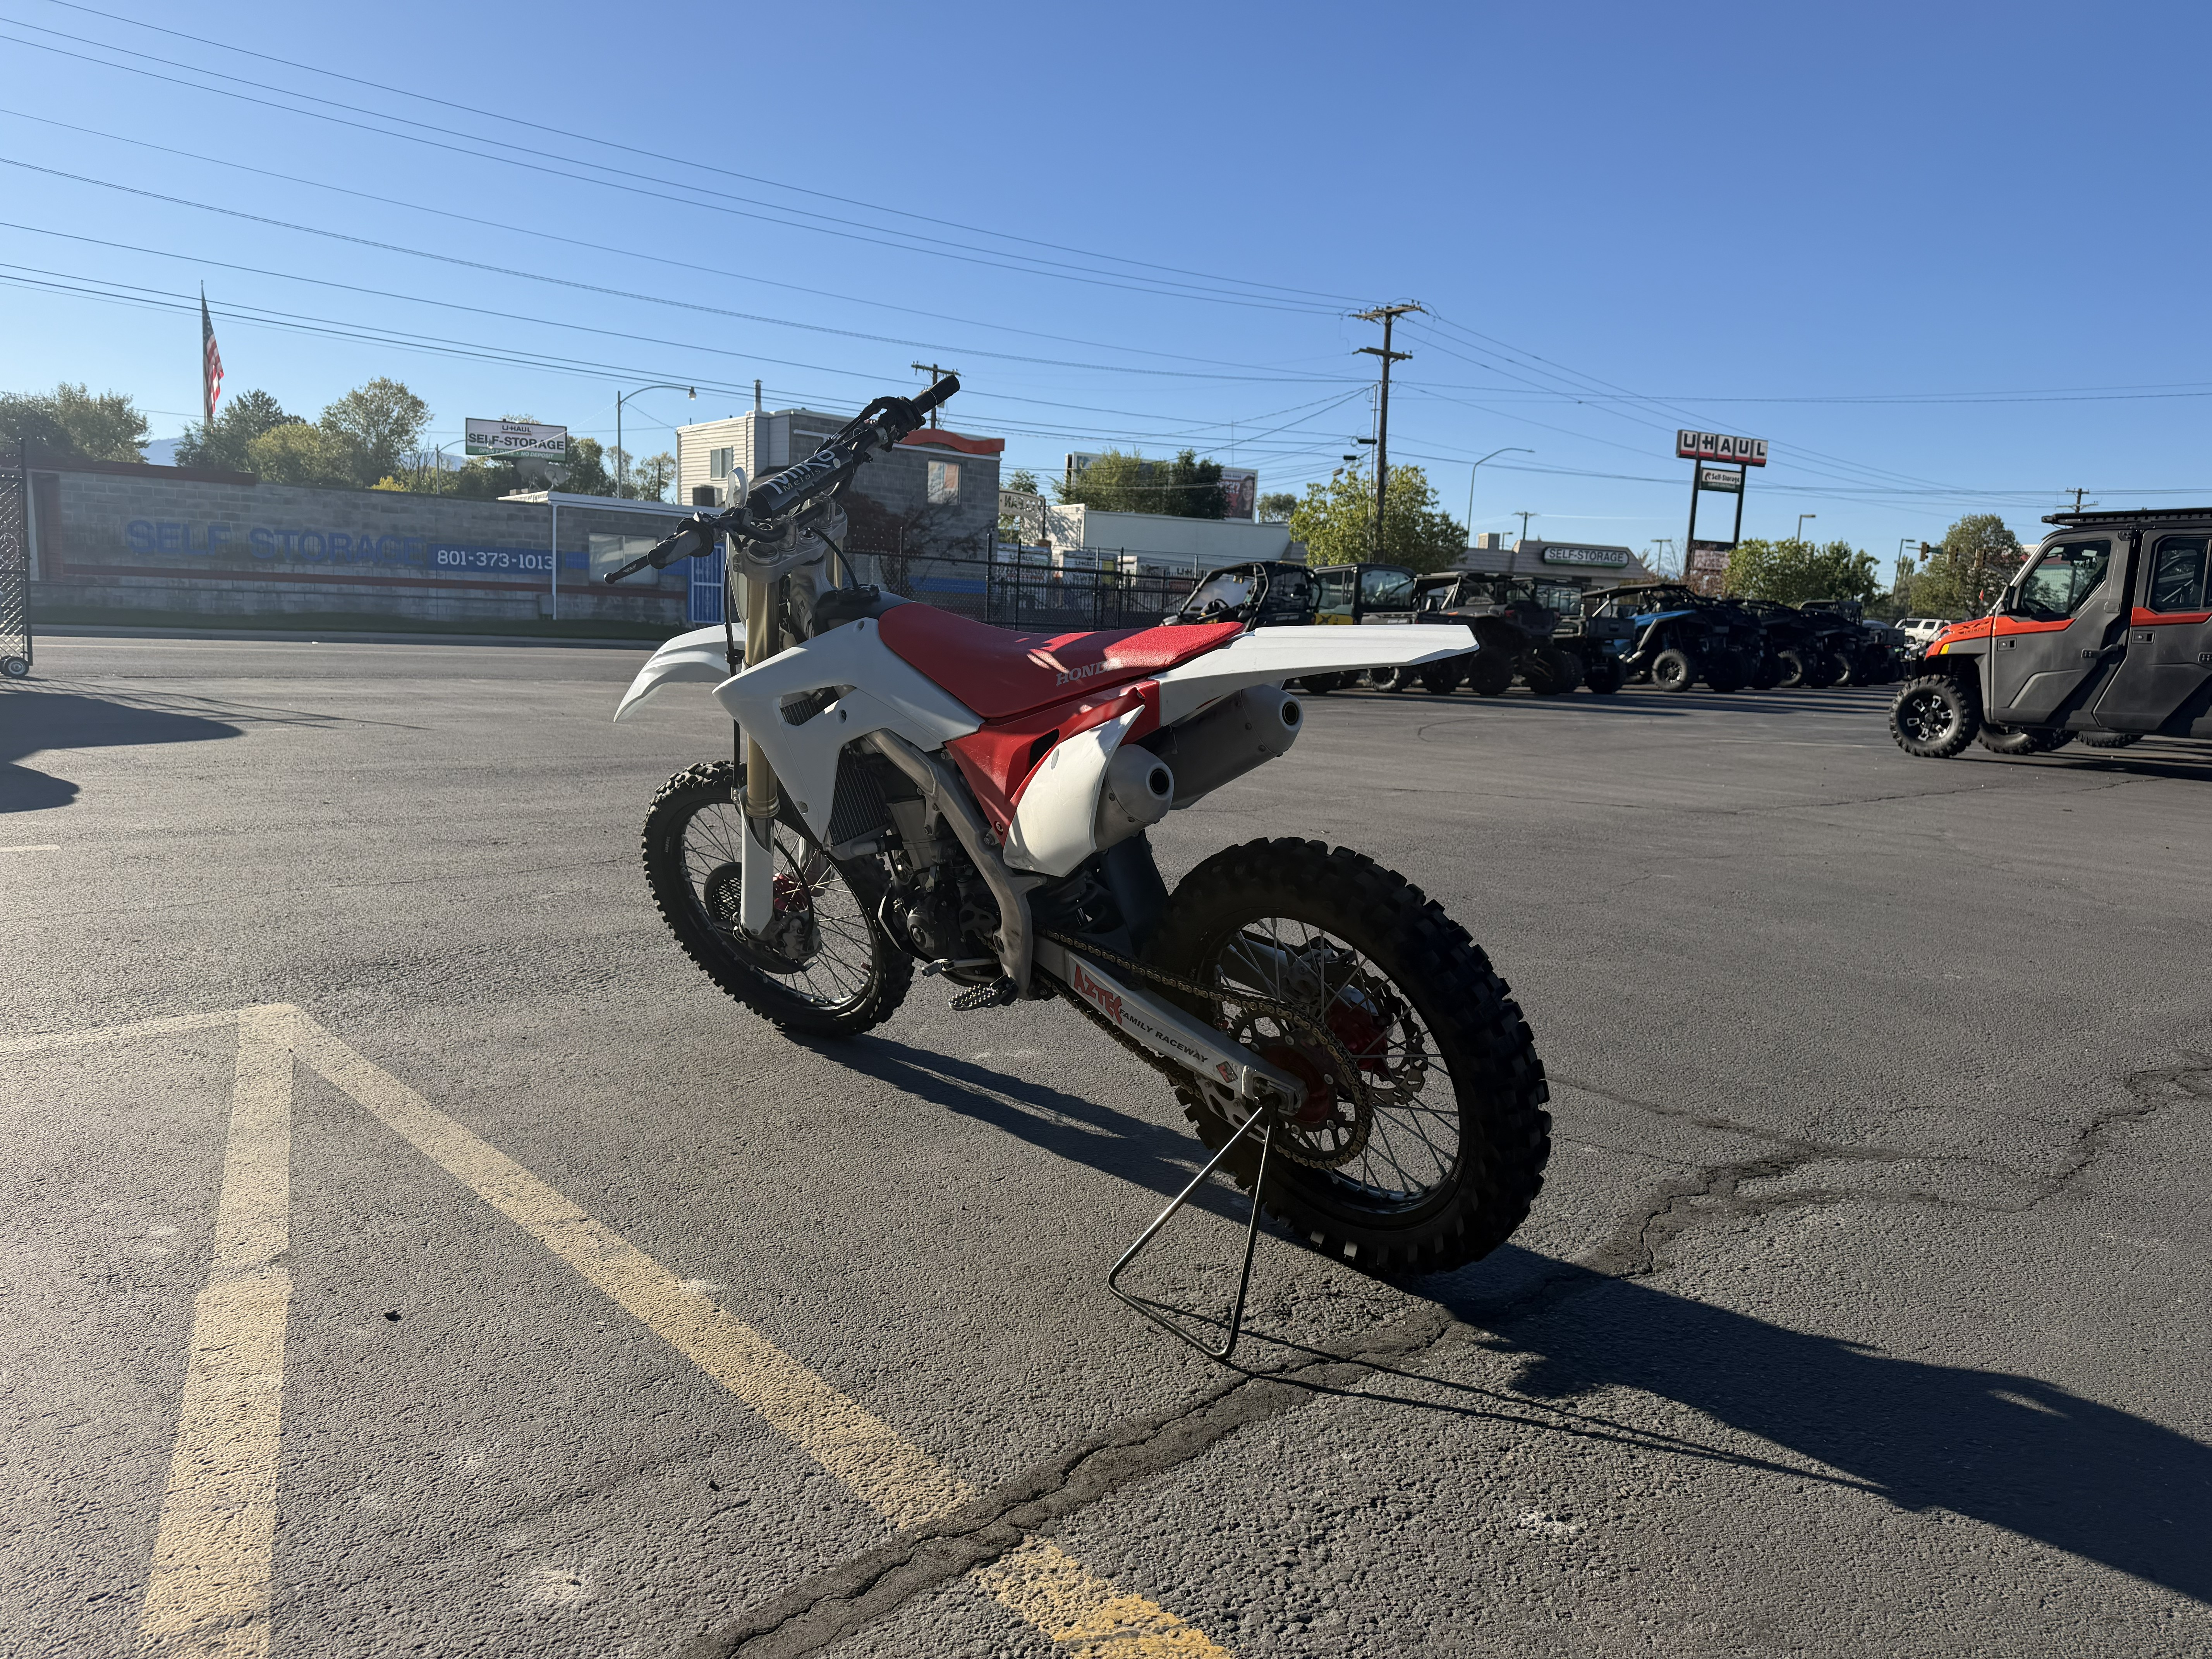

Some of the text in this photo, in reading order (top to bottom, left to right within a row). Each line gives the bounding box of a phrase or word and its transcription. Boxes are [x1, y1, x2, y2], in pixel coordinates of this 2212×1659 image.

[468, 433, 564, 450] SELF-STORAGE
[783, 468, 821, 491] Metals
[1712, 472, 1740, 483] Self-Storage
[127, 520, 426, 565] SELF STORAGE
[437, 550, 553, 570] 801-373-1013
[1549, 548, 1623, 562] SELF-STORAGE
[1073, 964, 1122, 1025] AZTEC
[1119, 1008, 1209, 1063] FAMILY RACEWAY
